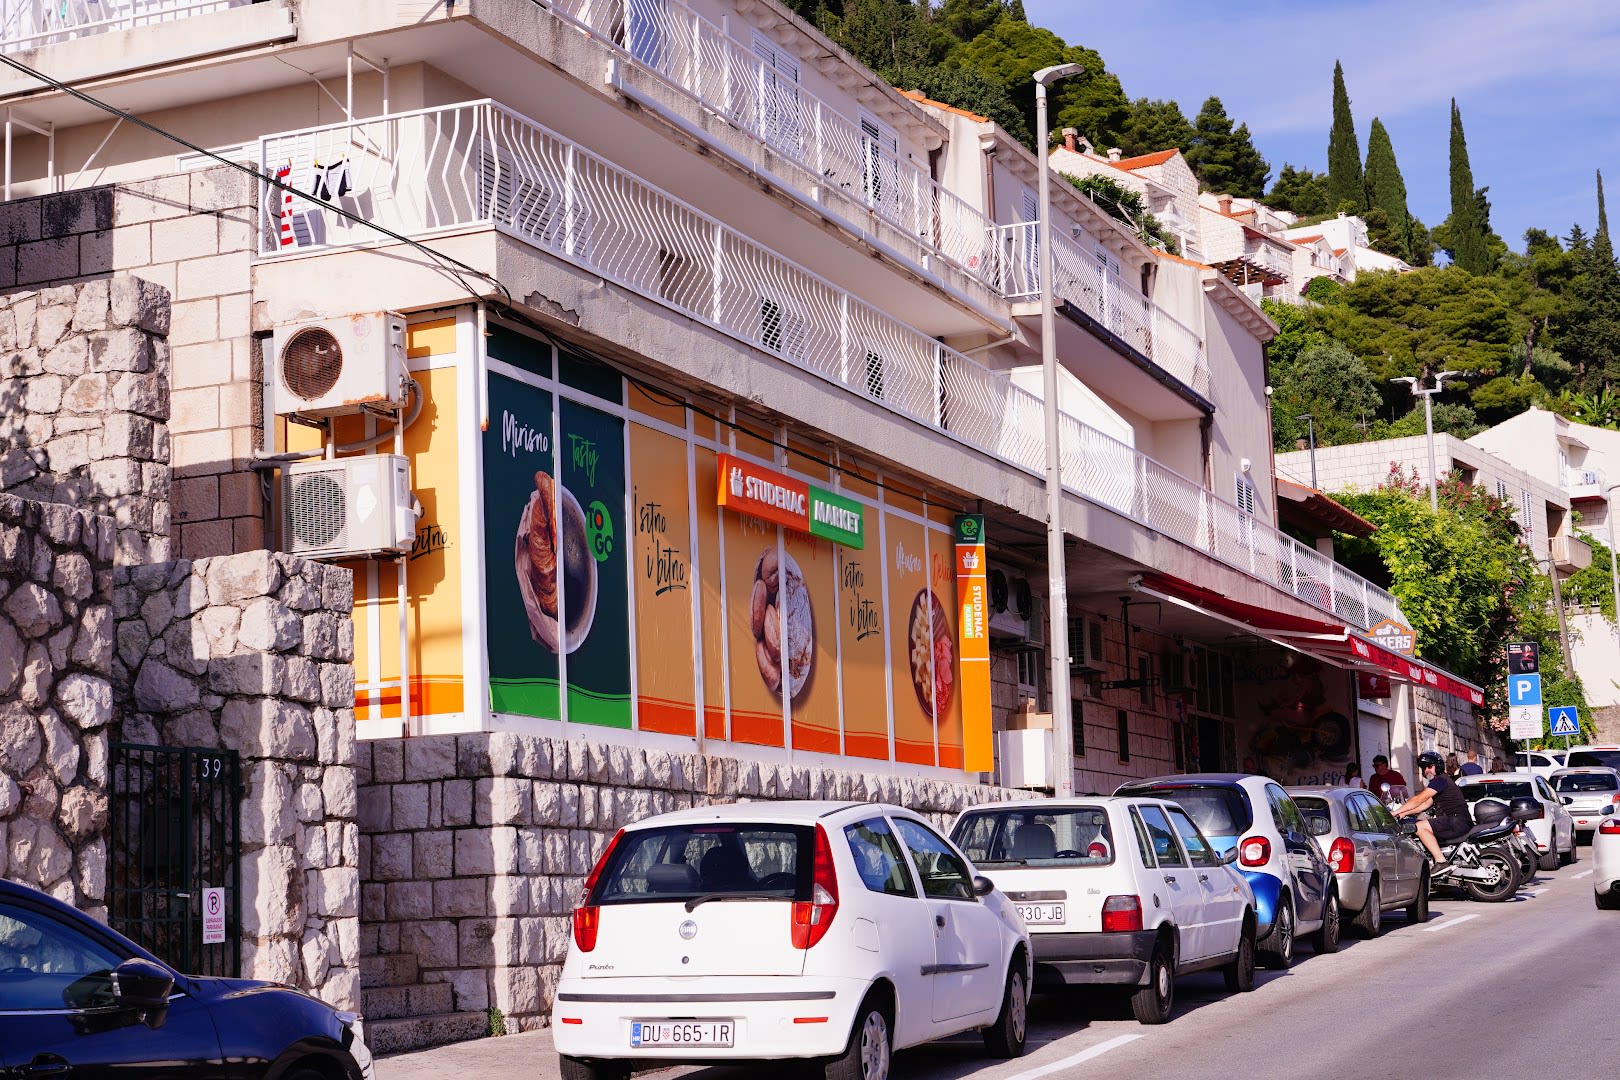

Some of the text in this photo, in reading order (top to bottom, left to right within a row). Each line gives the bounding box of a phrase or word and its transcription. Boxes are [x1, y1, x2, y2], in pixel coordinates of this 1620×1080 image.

[503, 410, 548, 458] Mirisno
[568, 433, 600, 487] Tasty
[586, 506, 604, 531] TO
[746, 475, 806, 516] STUDENAC
[814, 499, 860, 534] MARKET
[640, 502, 666, 543] sitno
[594, 533, 614, 554] GO
[646, 546, 654, 579] i
[844, 561, 864, 595] sitno
[972, 585, 984, 639] STUDENAC
[1369, 635, 1411, 650] KERS
[1517, 680, 1532, 700] P
[202, 758, 222, 778] 39
[642, 1025, 661, 1042] DU
[672, 1025, 730, 1042] 665-IR
